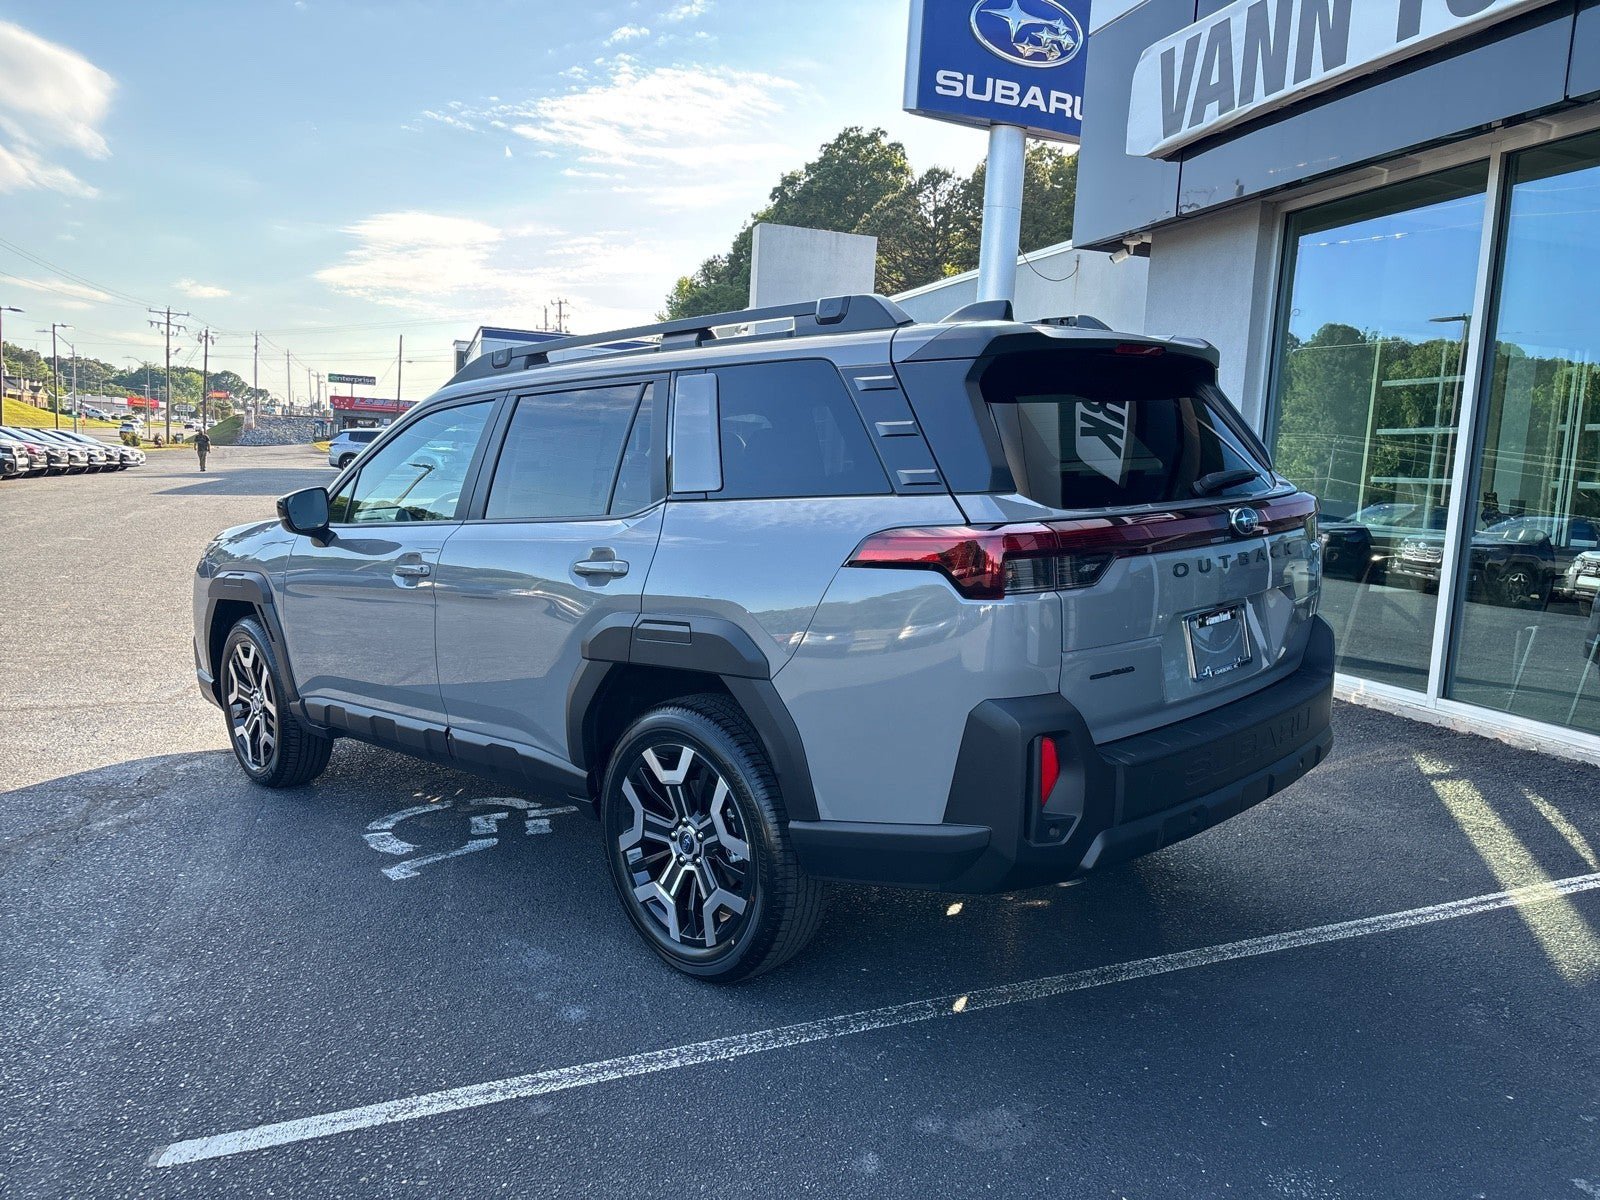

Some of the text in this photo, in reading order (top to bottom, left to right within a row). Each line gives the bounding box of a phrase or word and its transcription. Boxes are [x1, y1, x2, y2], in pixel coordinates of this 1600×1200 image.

[1160, 0, 1352, 140] VANN
[329, 374, 376, 385] enterprise
[1172, 542, 1292, 578] OUTBACK
